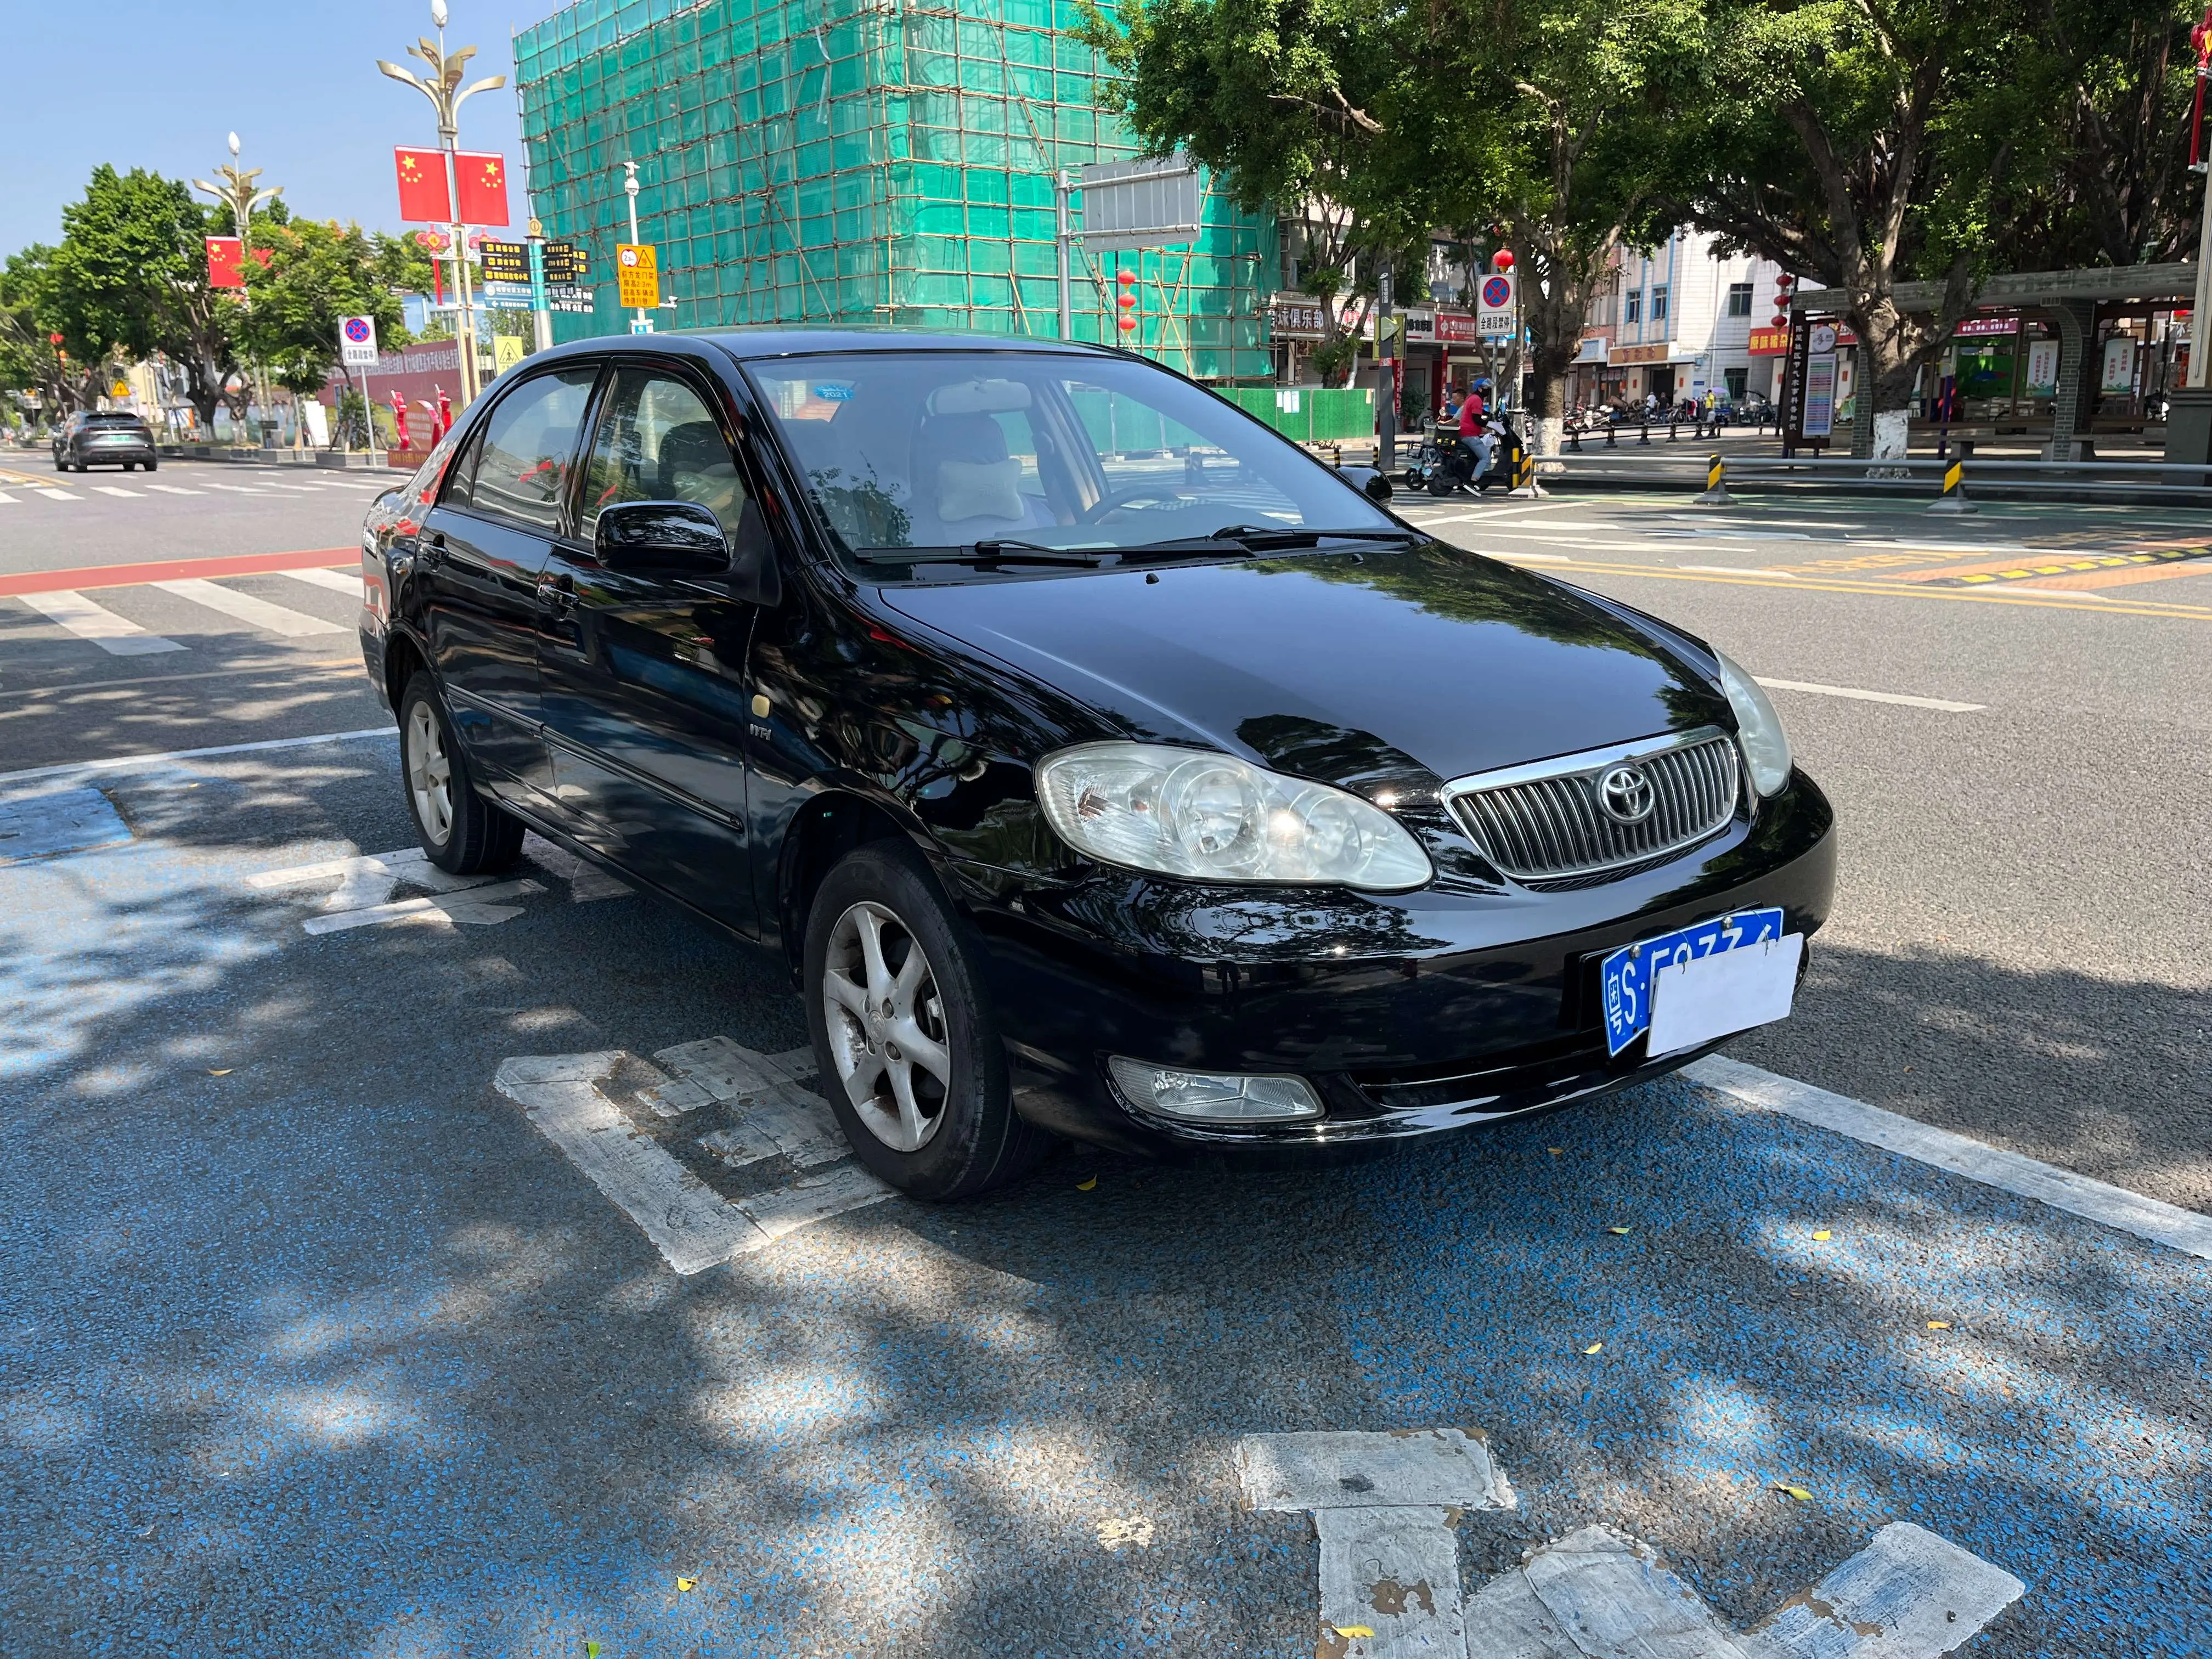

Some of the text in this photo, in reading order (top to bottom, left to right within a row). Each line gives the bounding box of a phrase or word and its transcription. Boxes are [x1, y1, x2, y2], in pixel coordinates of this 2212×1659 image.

[1481, 316, 1509, 329] 全路段禁停
